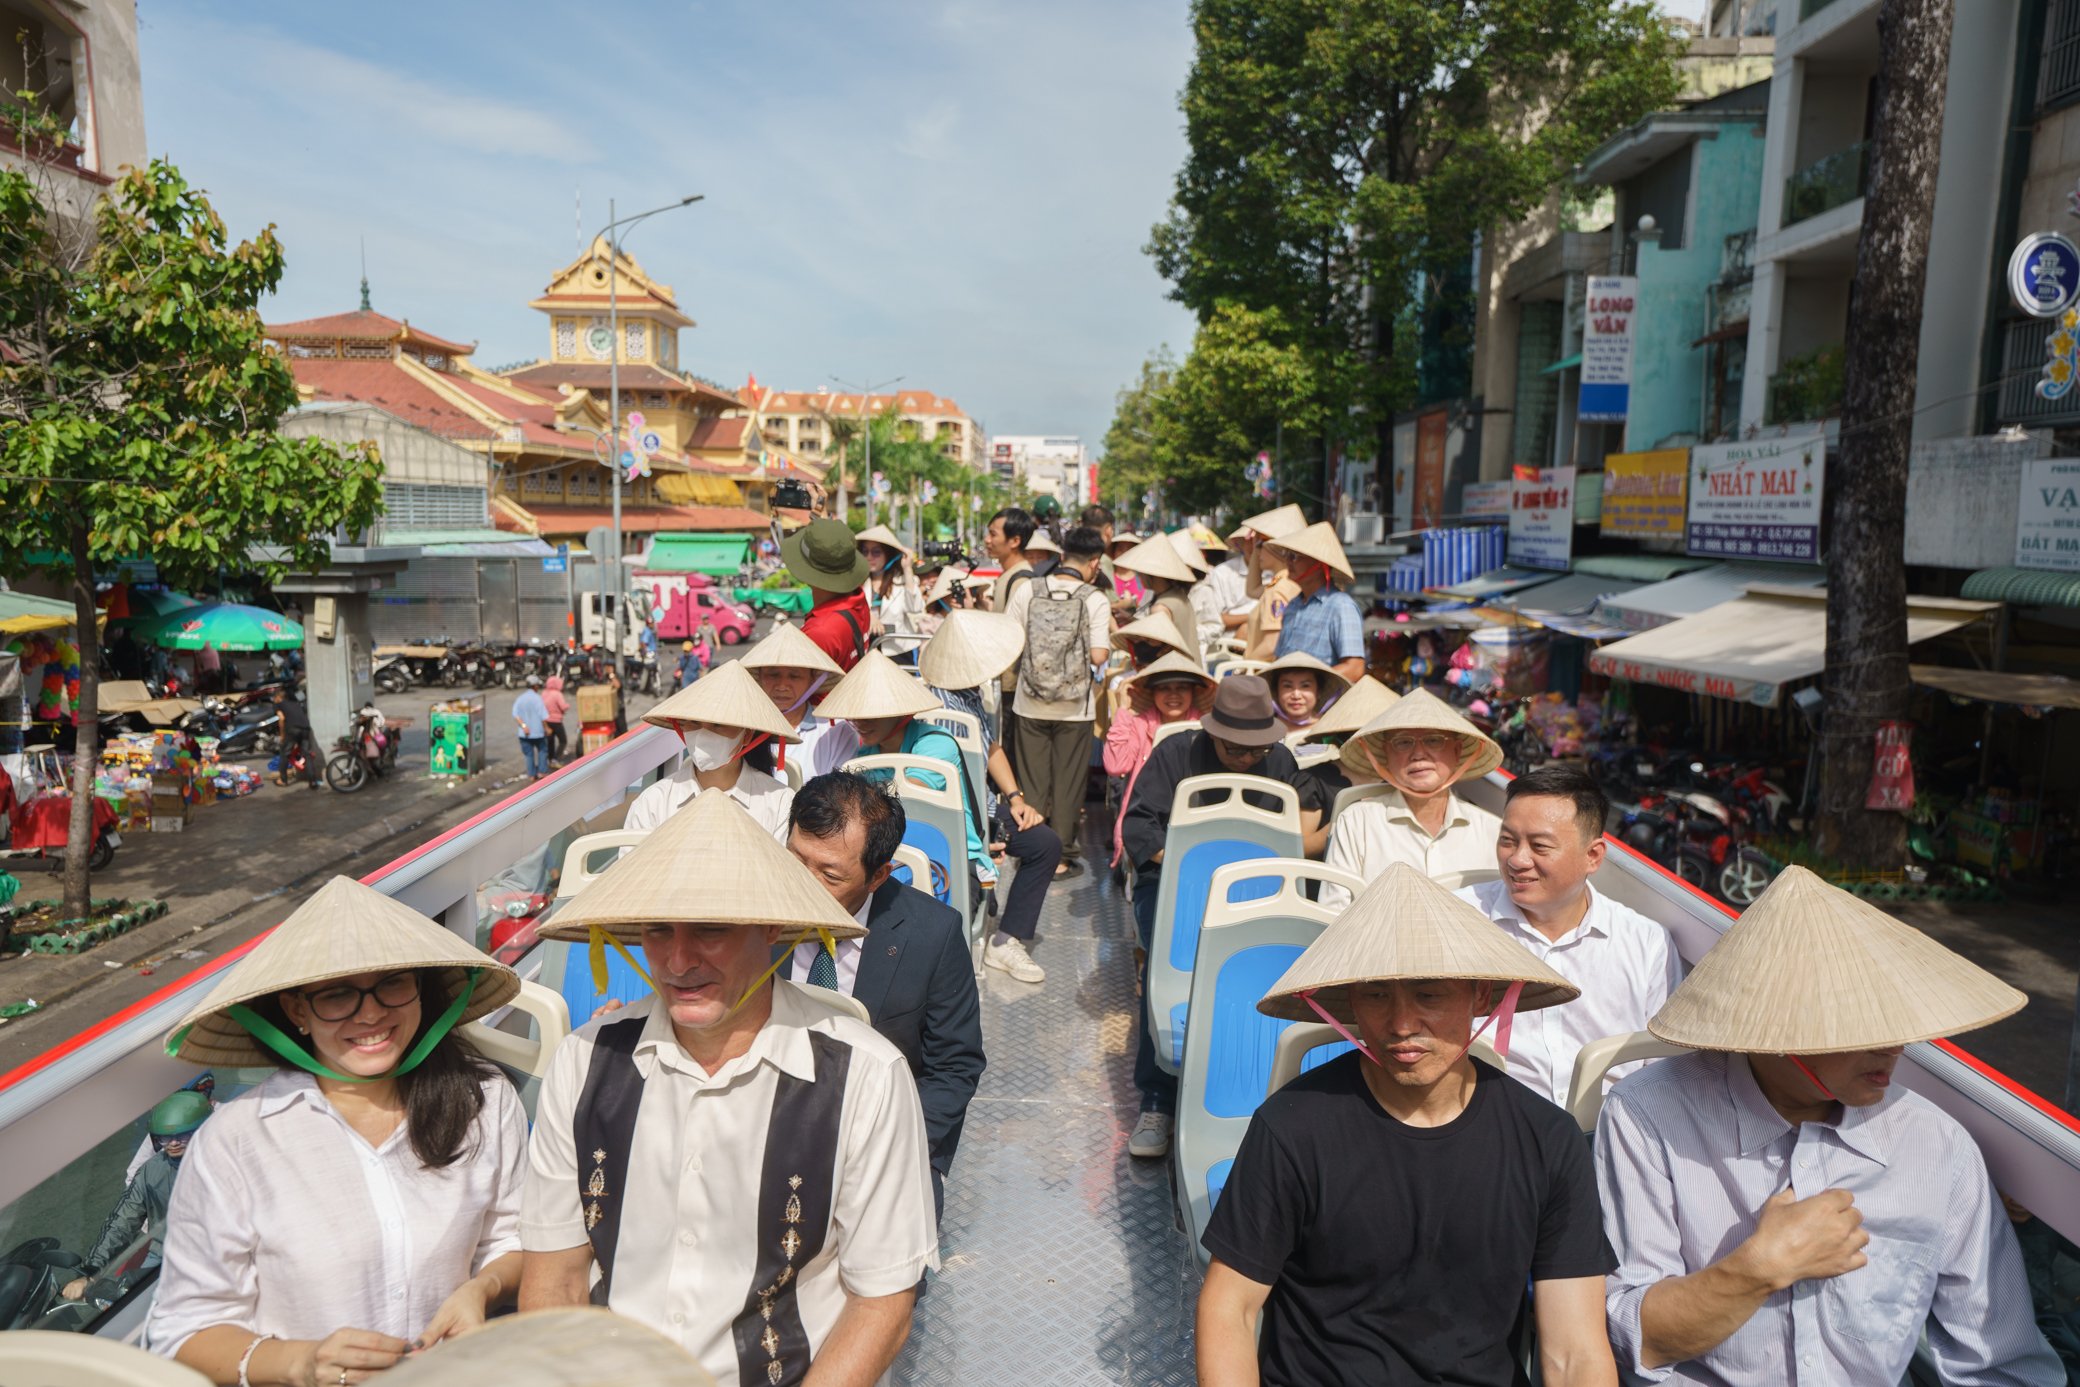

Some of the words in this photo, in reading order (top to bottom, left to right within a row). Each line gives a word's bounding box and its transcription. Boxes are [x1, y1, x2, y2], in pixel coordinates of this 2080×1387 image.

[1589, 297, 1634, 313] LONG
[1727, 448, 1752, 460] HOA
[1708, 459, 1756, 497] NHẤT
[1760, 468, 1798, 496] MAI
[1623, 664, 1641, 682] XE
